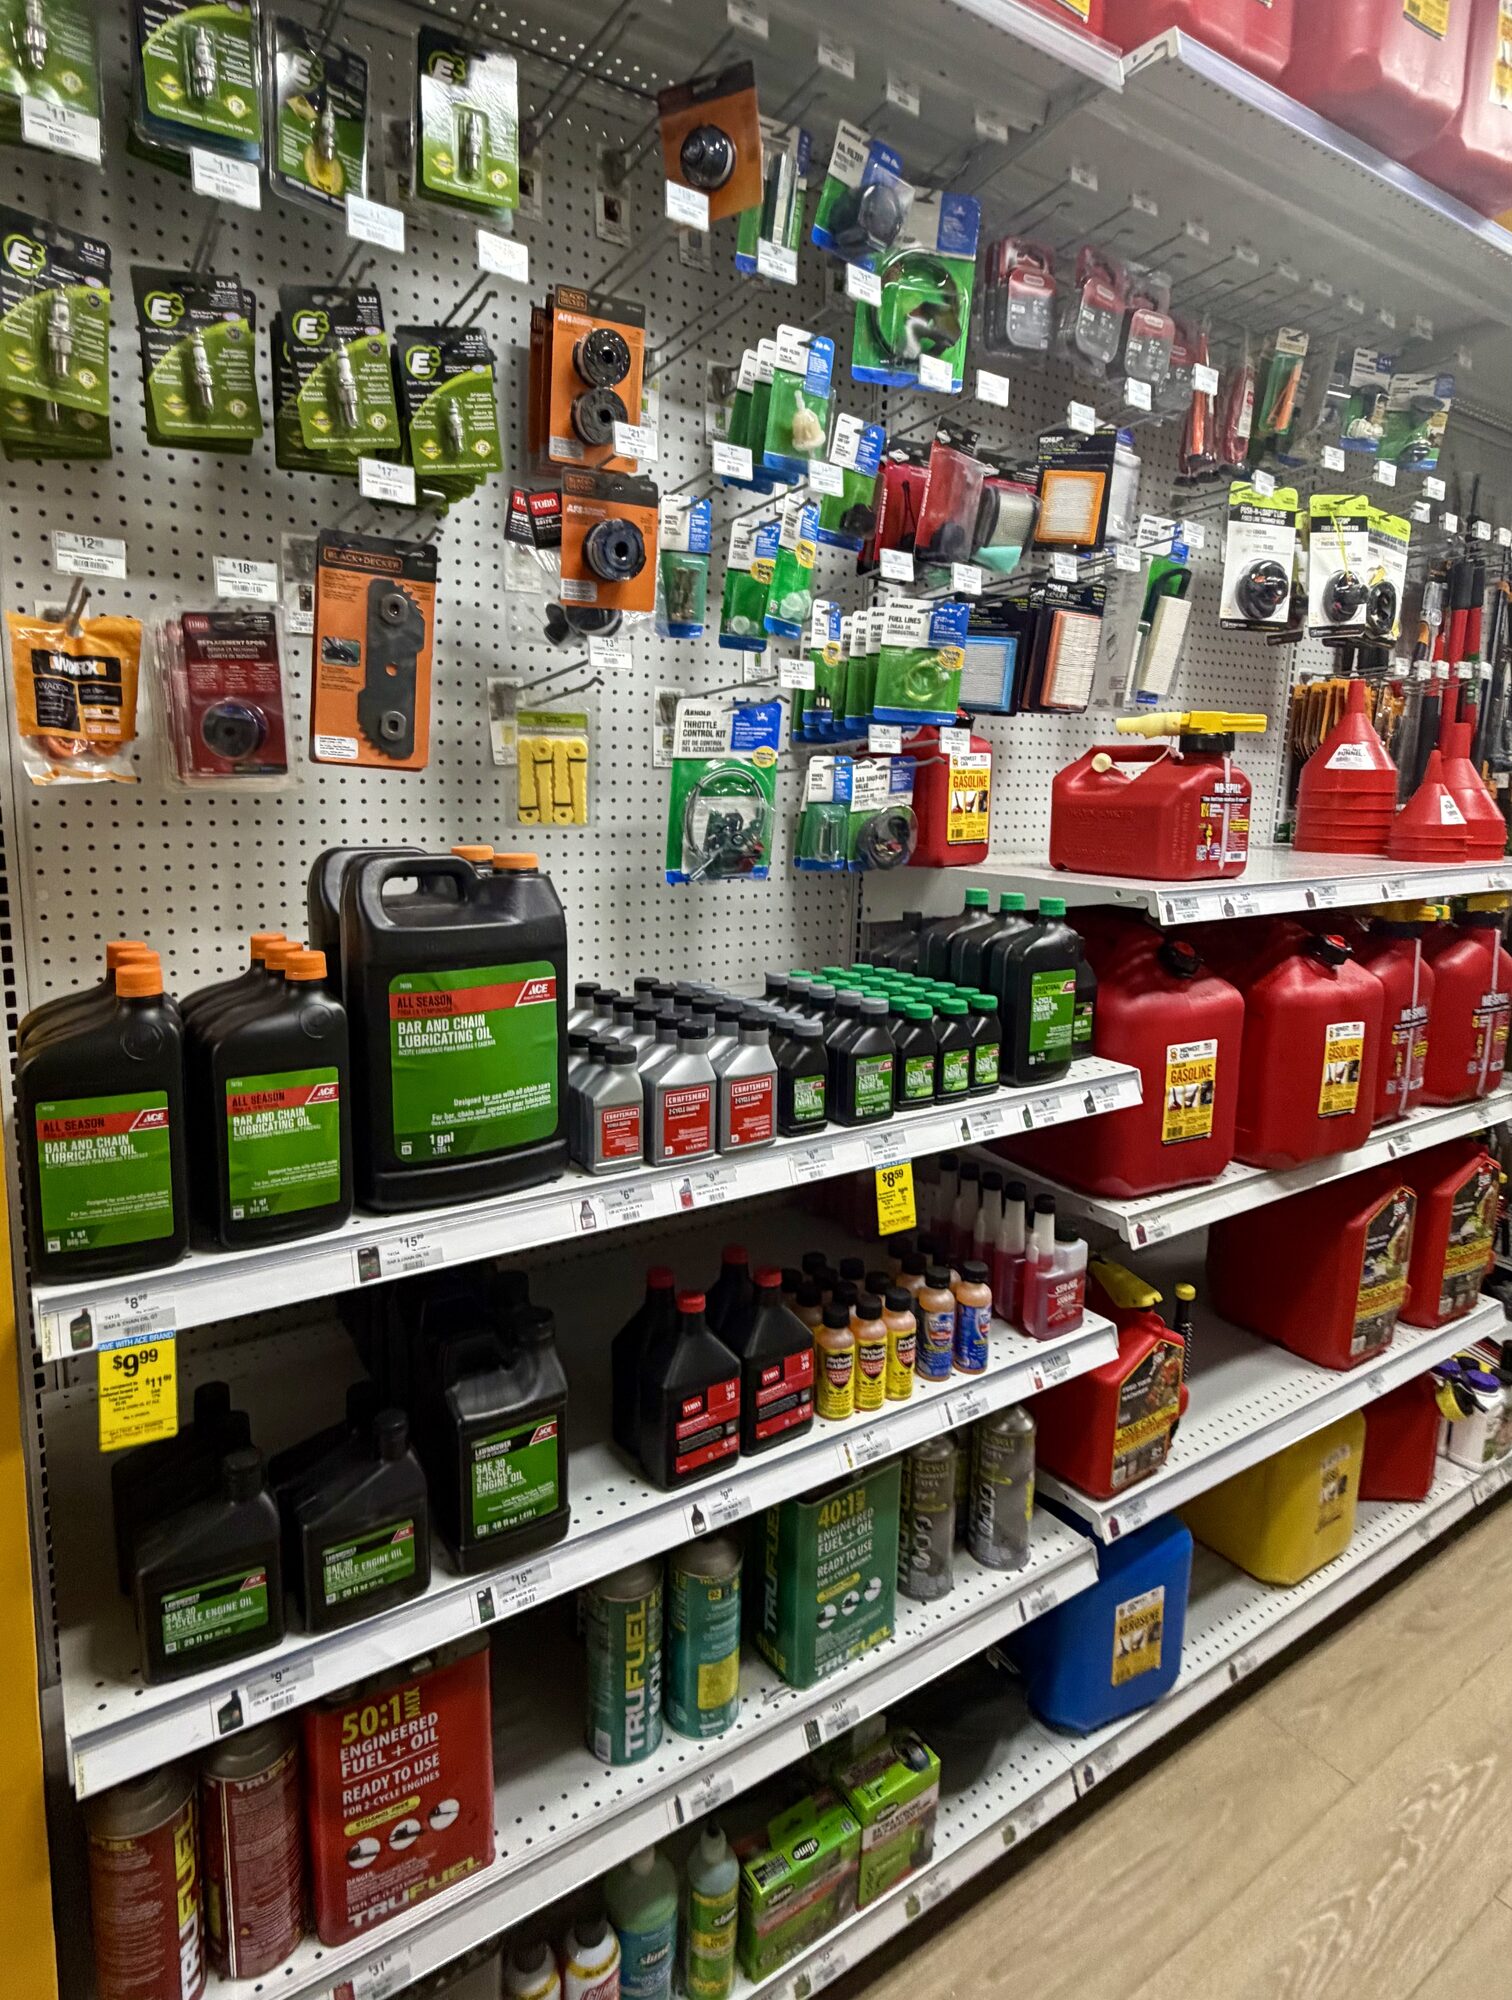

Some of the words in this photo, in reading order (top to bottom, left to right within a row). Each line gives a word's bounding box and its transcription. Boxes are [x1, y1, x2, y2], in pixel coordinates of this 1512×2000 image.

[532, 498, 556, 509] TORO
[682, 730, 714, 738] CONTROL
[716, 730, 726, 738] KIT
[683, 721, 718, 729] THROTTLE
[953, 775, 987, 788] GASOLINE
[529, 983, 548, 995] ACE
[398, 998, 414, 1009] ALL
[416, 994, 453, 1007] SEASON
[398, 1021, 422, 1035] BAR
[426, 1018, 449, 1031] AND
[453, 1014, 486, 1029] CHAIN
[398, 1029, 473, 1048] LUBRICATING
[476, 1026, 492, 1039] OIL
[1328, 1045, 1360, 1061] GASOLINE
[1170, 1064, 1212, 1084] GASOLINE
[318, 1086, 335, 1096] ACE
[734, 1081, 770, 1095] CRAFTSMAN
[232, 1097, 247, 1107] ALL
[251, 1092, 285, 1105] SEASON
[668, 1092, 707, 1105] CRAFTSMAN
[43, 1122, 61, 1132] ALL
[65, 1117, 105, 1131] SEASON
[143, 1112, 165, 1123] ACE
[234, 1116, 252, 1127] BAR
[256, 1112, 274, 1123] AND
[278, 1108, 305, 1119] CHAIN
[234, 1118, 294, 1137] LUBRICATING
[297, 1116, 311, 1127] OIL
[45, 1141, 67, 1154] BAR
[71, 1139, 93, 1151] AND
[96, 1135, 129, 1148] CHAIN
[437, 1132, 454, 1146] gal
[45, 1146, 116, 1165] LUBRICATING
[120, 1144, 137, 1156] OIL
[98, 1342, 114, 1352] AVE
[115, 1337, 133, 1348] WITH
[134, 1335, 147, 1346] ACE
[149, 1331, 174, 1342] BRAND
[476, 1463, 492, 1475] SAE
[495, 1458, 506, 1469] 30
[476, 1465, 512, 1483] 4-CYCLE
[476, 1477, 508, 1493] ENGINE
[510, 1470, 523, 1482] OIL
[818, 1494, 855, 1528] 40:1
[818, 1507, 874, 1543] ENGINEERED
[818, 1536, 843, 1556] FUEL
[857, 1520, 873, 1536] OIL
[817, 1556, 844, 1578] READY
[846, 1548, 856, 1563] TO
[858, 1539, 873, 1556] USE
[206, 1601, 238, 1619] ENGINE
[240, 1596, 253, 1608] OIL
[625, 1600, 647, 1758] TRUFUEL
[342, 1694, 400, 1745] 50:1
[404, 1686, 421, 1719] MIX
[340, 1712, 438, 1762] ENGINEERED
[342, 1751, 386, 1778] FUEL
[391, 1744, 406, 1757] +
[410, 1727, 439, 1750] OIL
[343, 1774, 389, 1805] READY
[393, 1766, 411, 1784] TO
[414, 1753, 440, 1775] USE
[344, 1805, 362, 1818] FOR
[365, 1789, 400, 1811] 2-CYCLE
[402, 1771, 440, 1794] ENGINES
[348, 1856, 482, 1928] TRUFUEL
